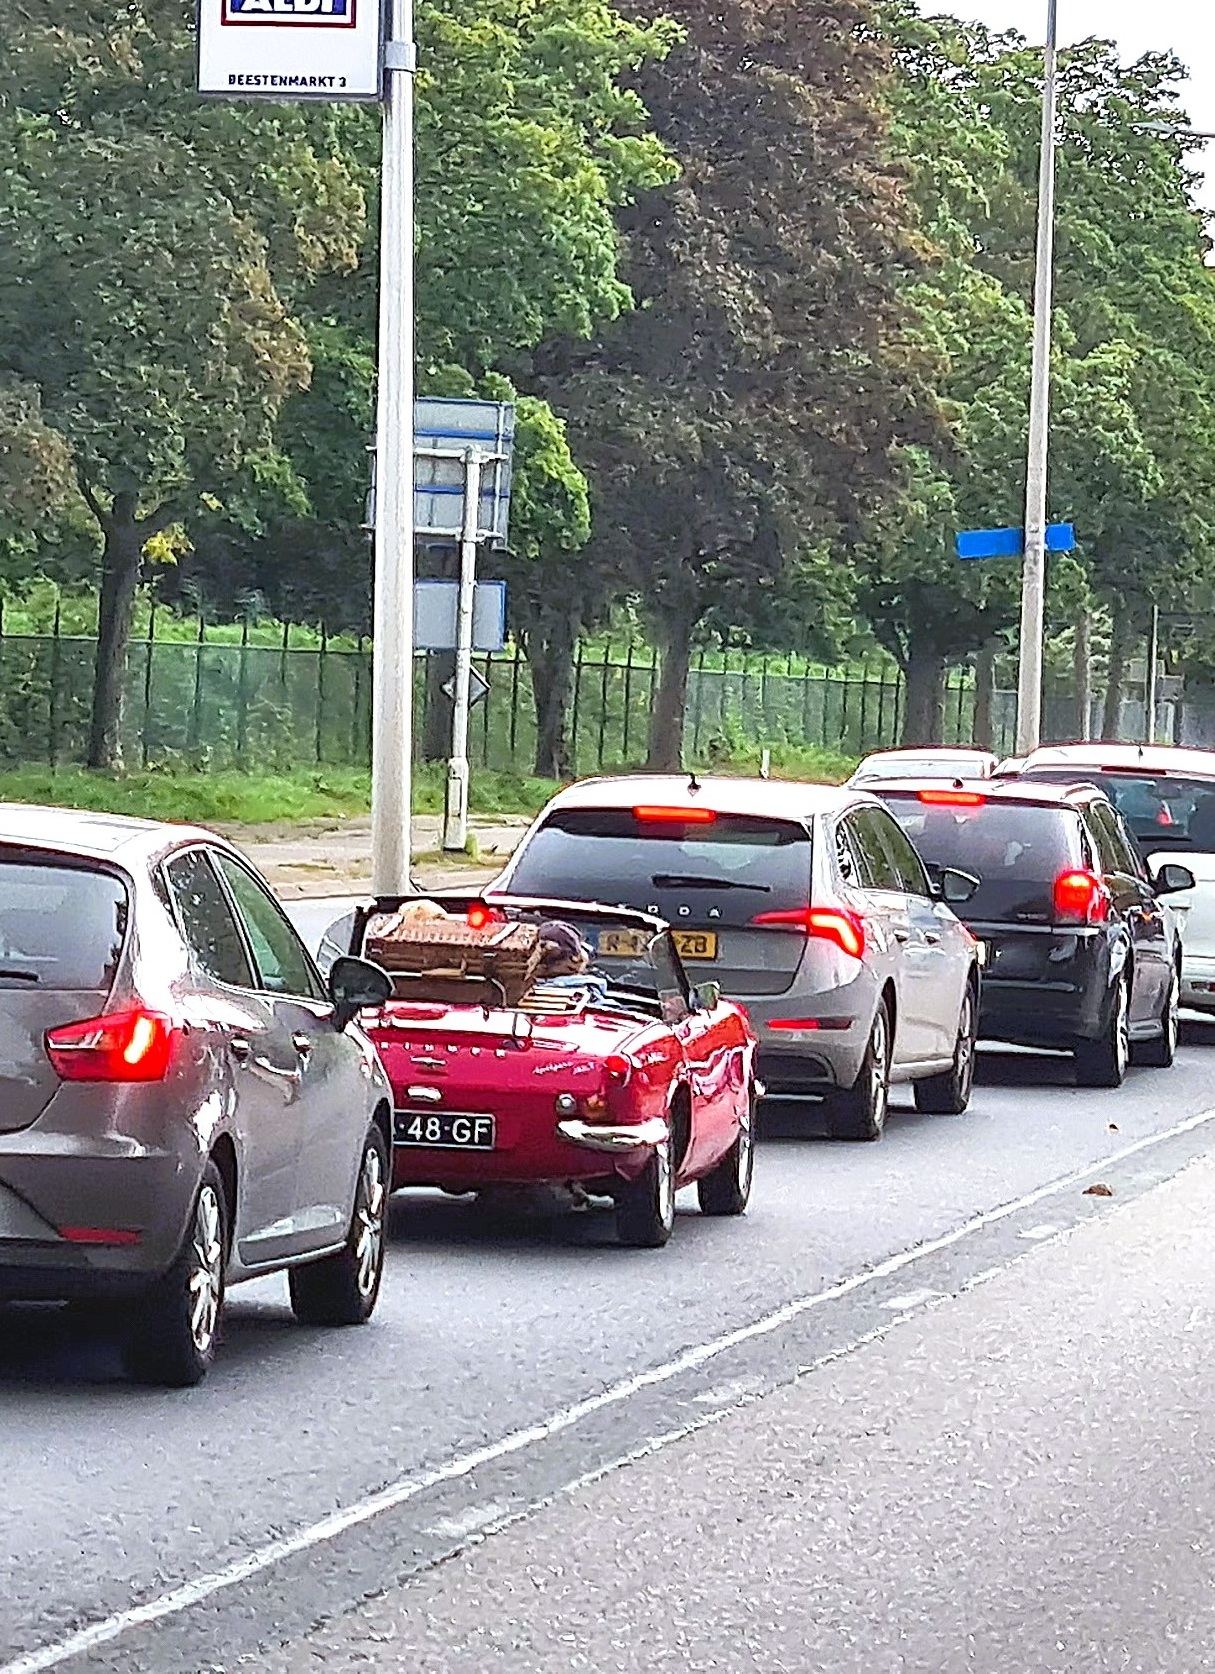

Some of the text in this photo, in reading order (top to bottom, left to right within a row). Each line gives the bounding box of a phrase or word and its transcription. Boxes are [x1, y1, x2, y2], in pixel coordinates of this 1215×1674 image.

[228, 74, 347, 88] BEESTENMARKT 3
[398, 1116, 492, 1144] -48-GF
